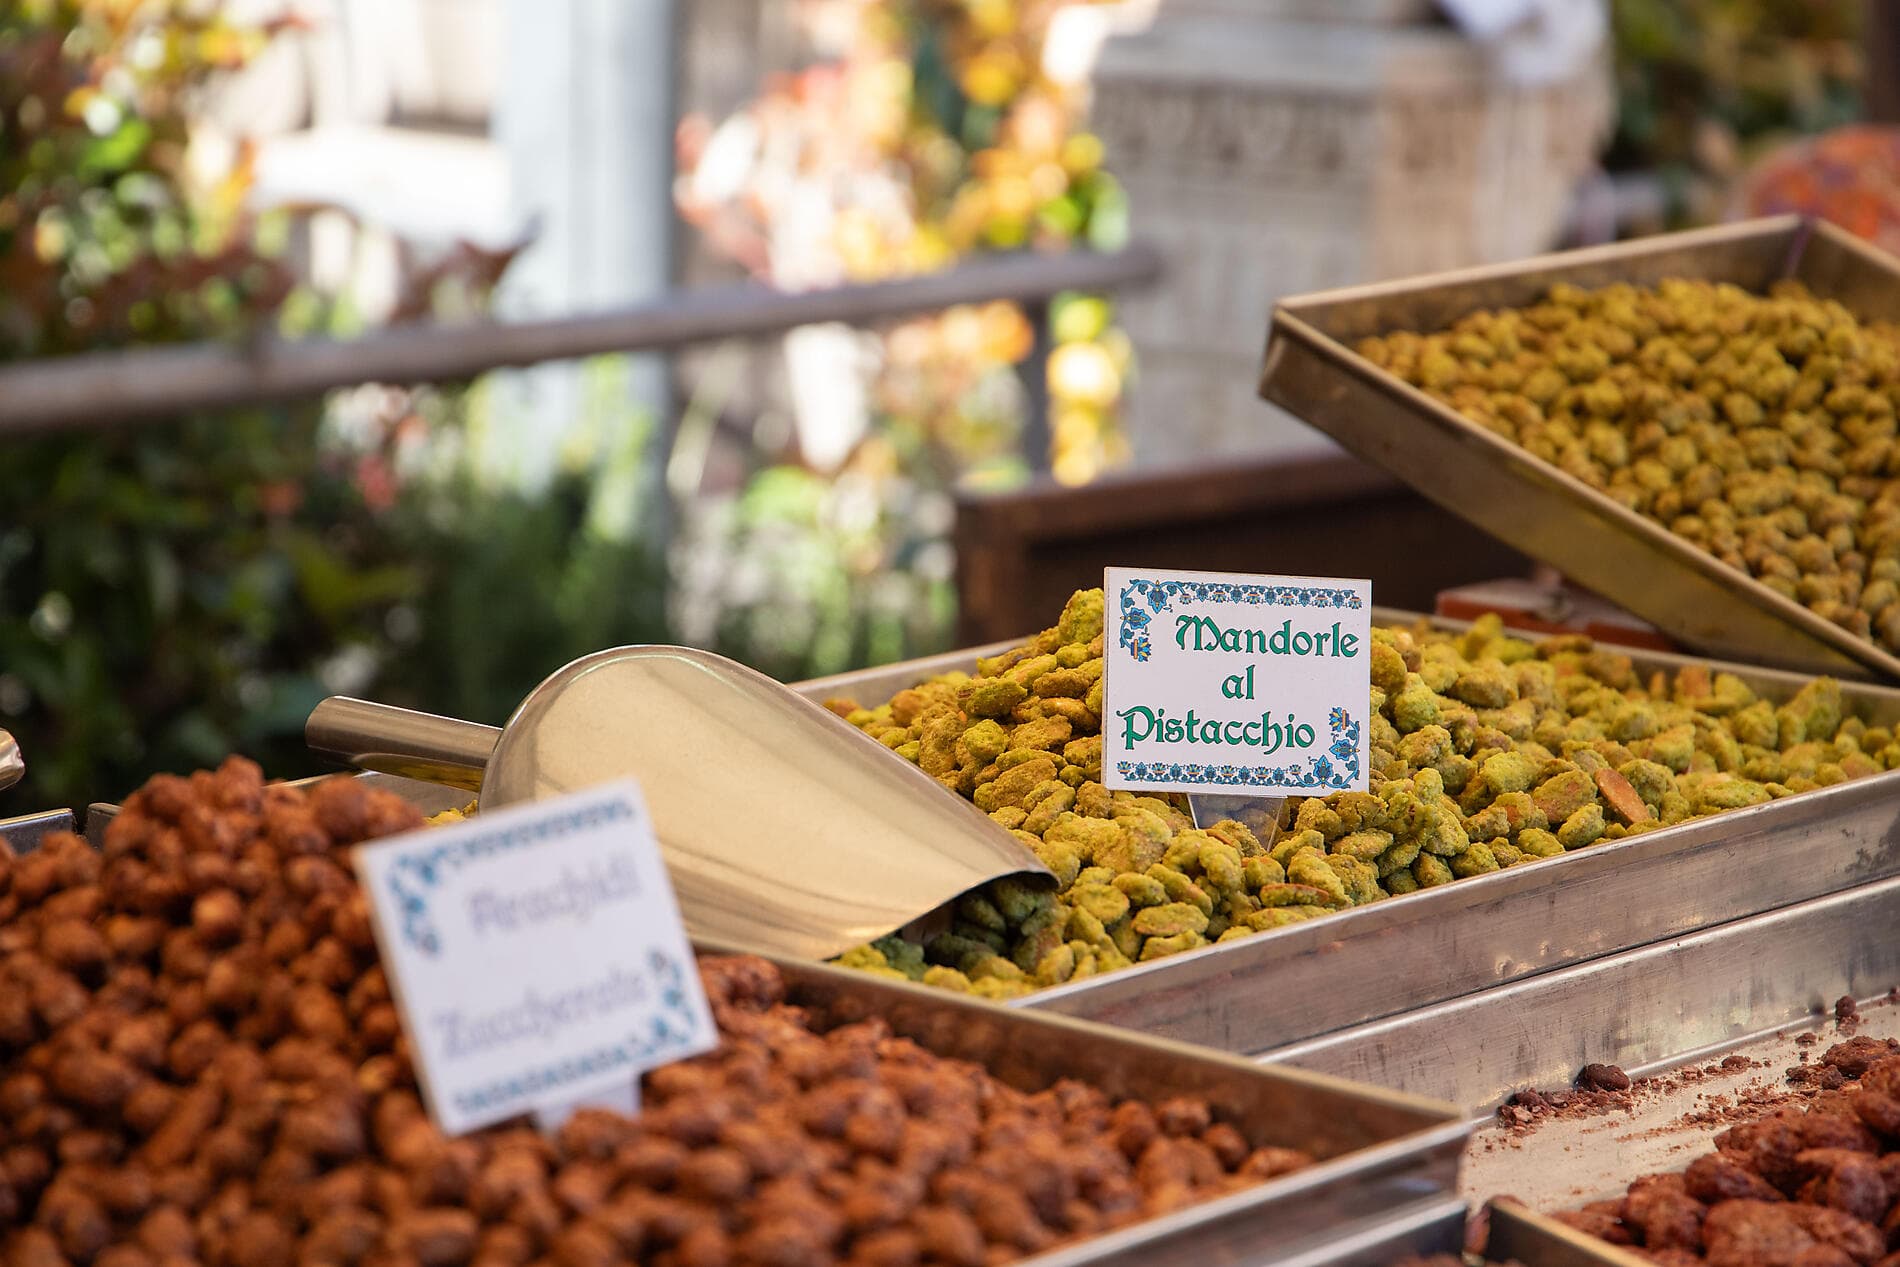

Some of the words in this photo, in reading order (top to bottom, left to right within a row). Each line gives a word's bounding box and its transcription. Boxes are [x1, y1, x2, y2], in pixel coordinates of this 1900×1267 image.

[1175, 614, 1360, 658] Mandorle
[1221, 664, 1256, 700] al
[1116, 705, 1316, 755] Pistacchio
